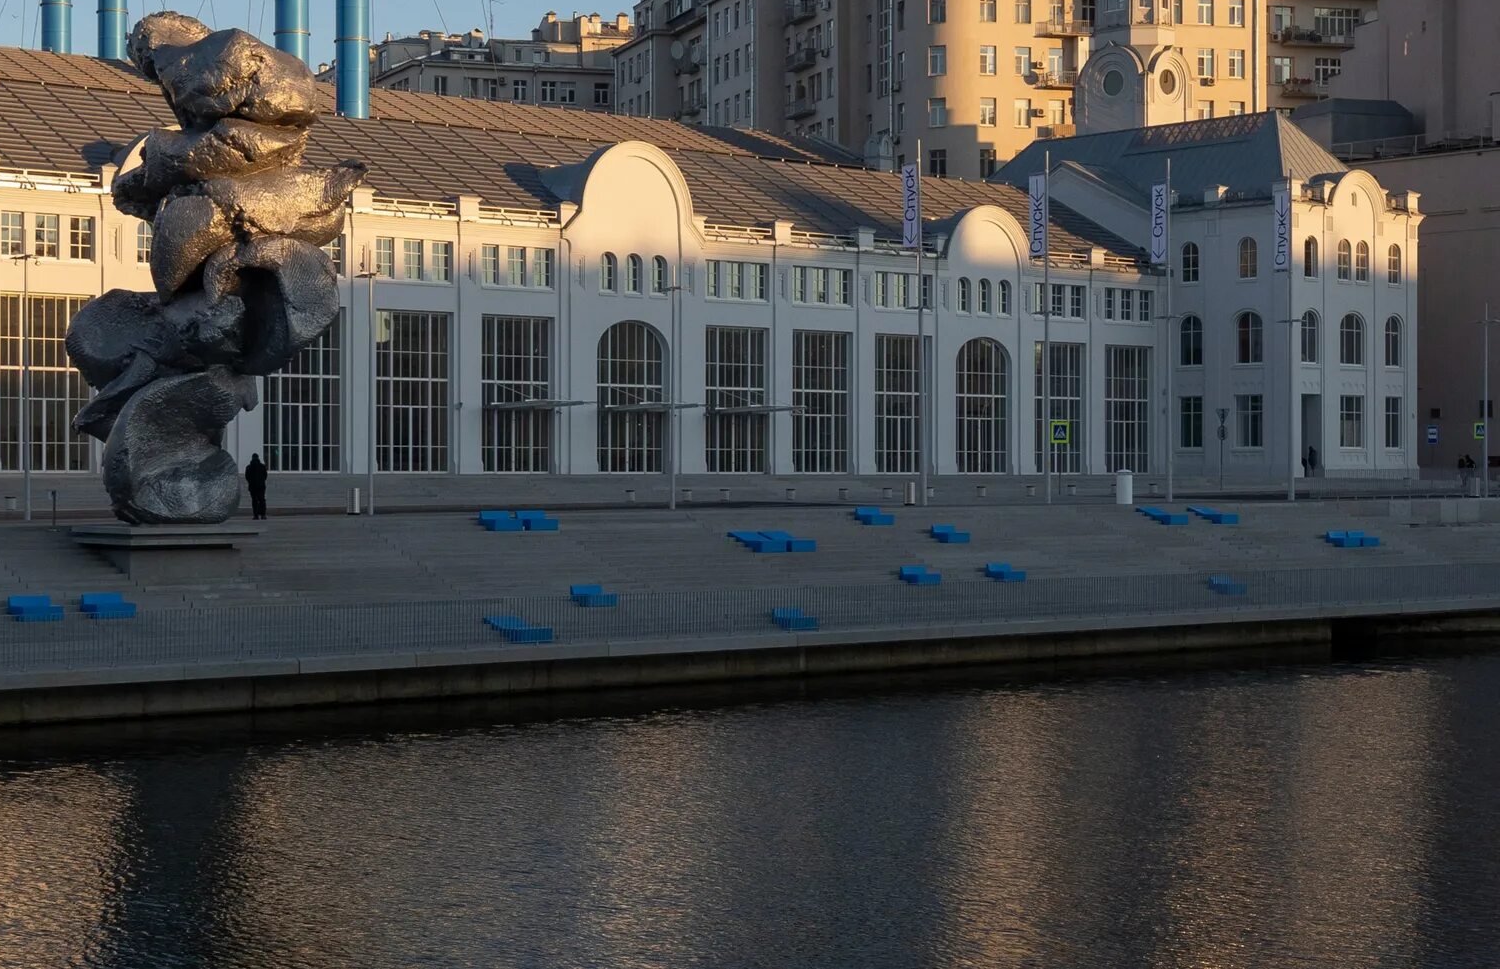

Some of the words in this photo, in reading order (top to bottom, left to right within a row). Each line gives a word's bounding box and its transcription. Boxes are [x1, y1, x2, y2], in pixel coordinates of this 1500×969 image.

[904, 167, 916, 222] Спуск
[1153, 187, 1165, 238] Спуск
[1030, 202, 1044, 254] Спуск
[1275, 217, 1288, 266] Спуск
